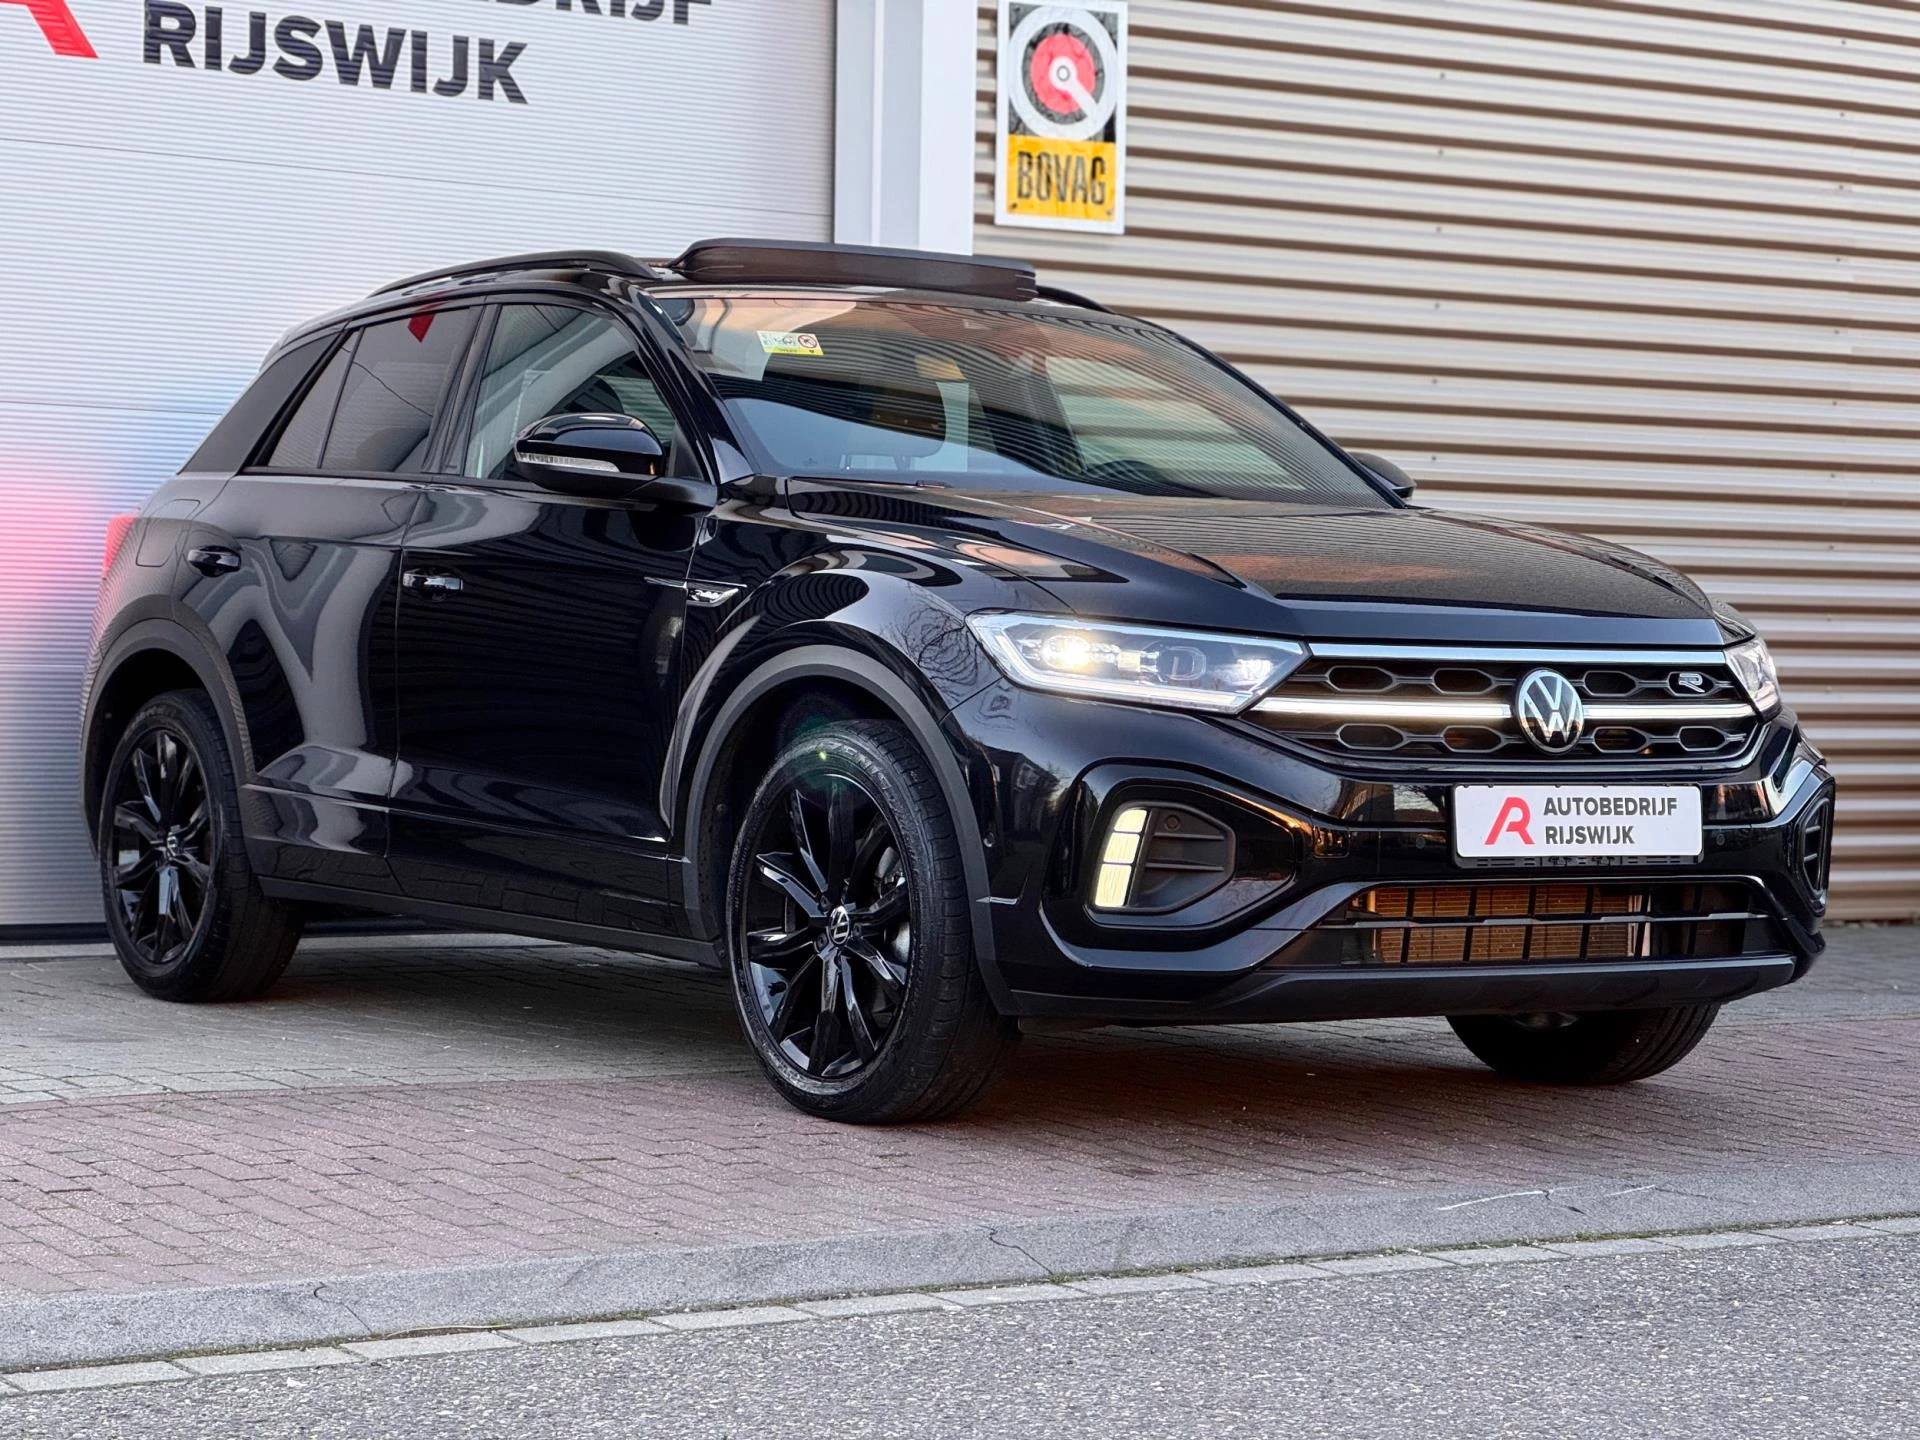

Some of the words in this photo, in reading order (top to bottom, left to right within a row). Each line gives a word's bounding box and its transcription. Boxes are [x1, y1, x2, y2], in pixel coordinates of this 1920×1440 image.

[143, 0, 528, 104] RIJSWIJK
[1017, 150, 1106, 206] BOVAG
[1543, 797, 1678, 816] AUTOBEDRIJF
[1545, 825, 1635, 845] RIJSWIJK
